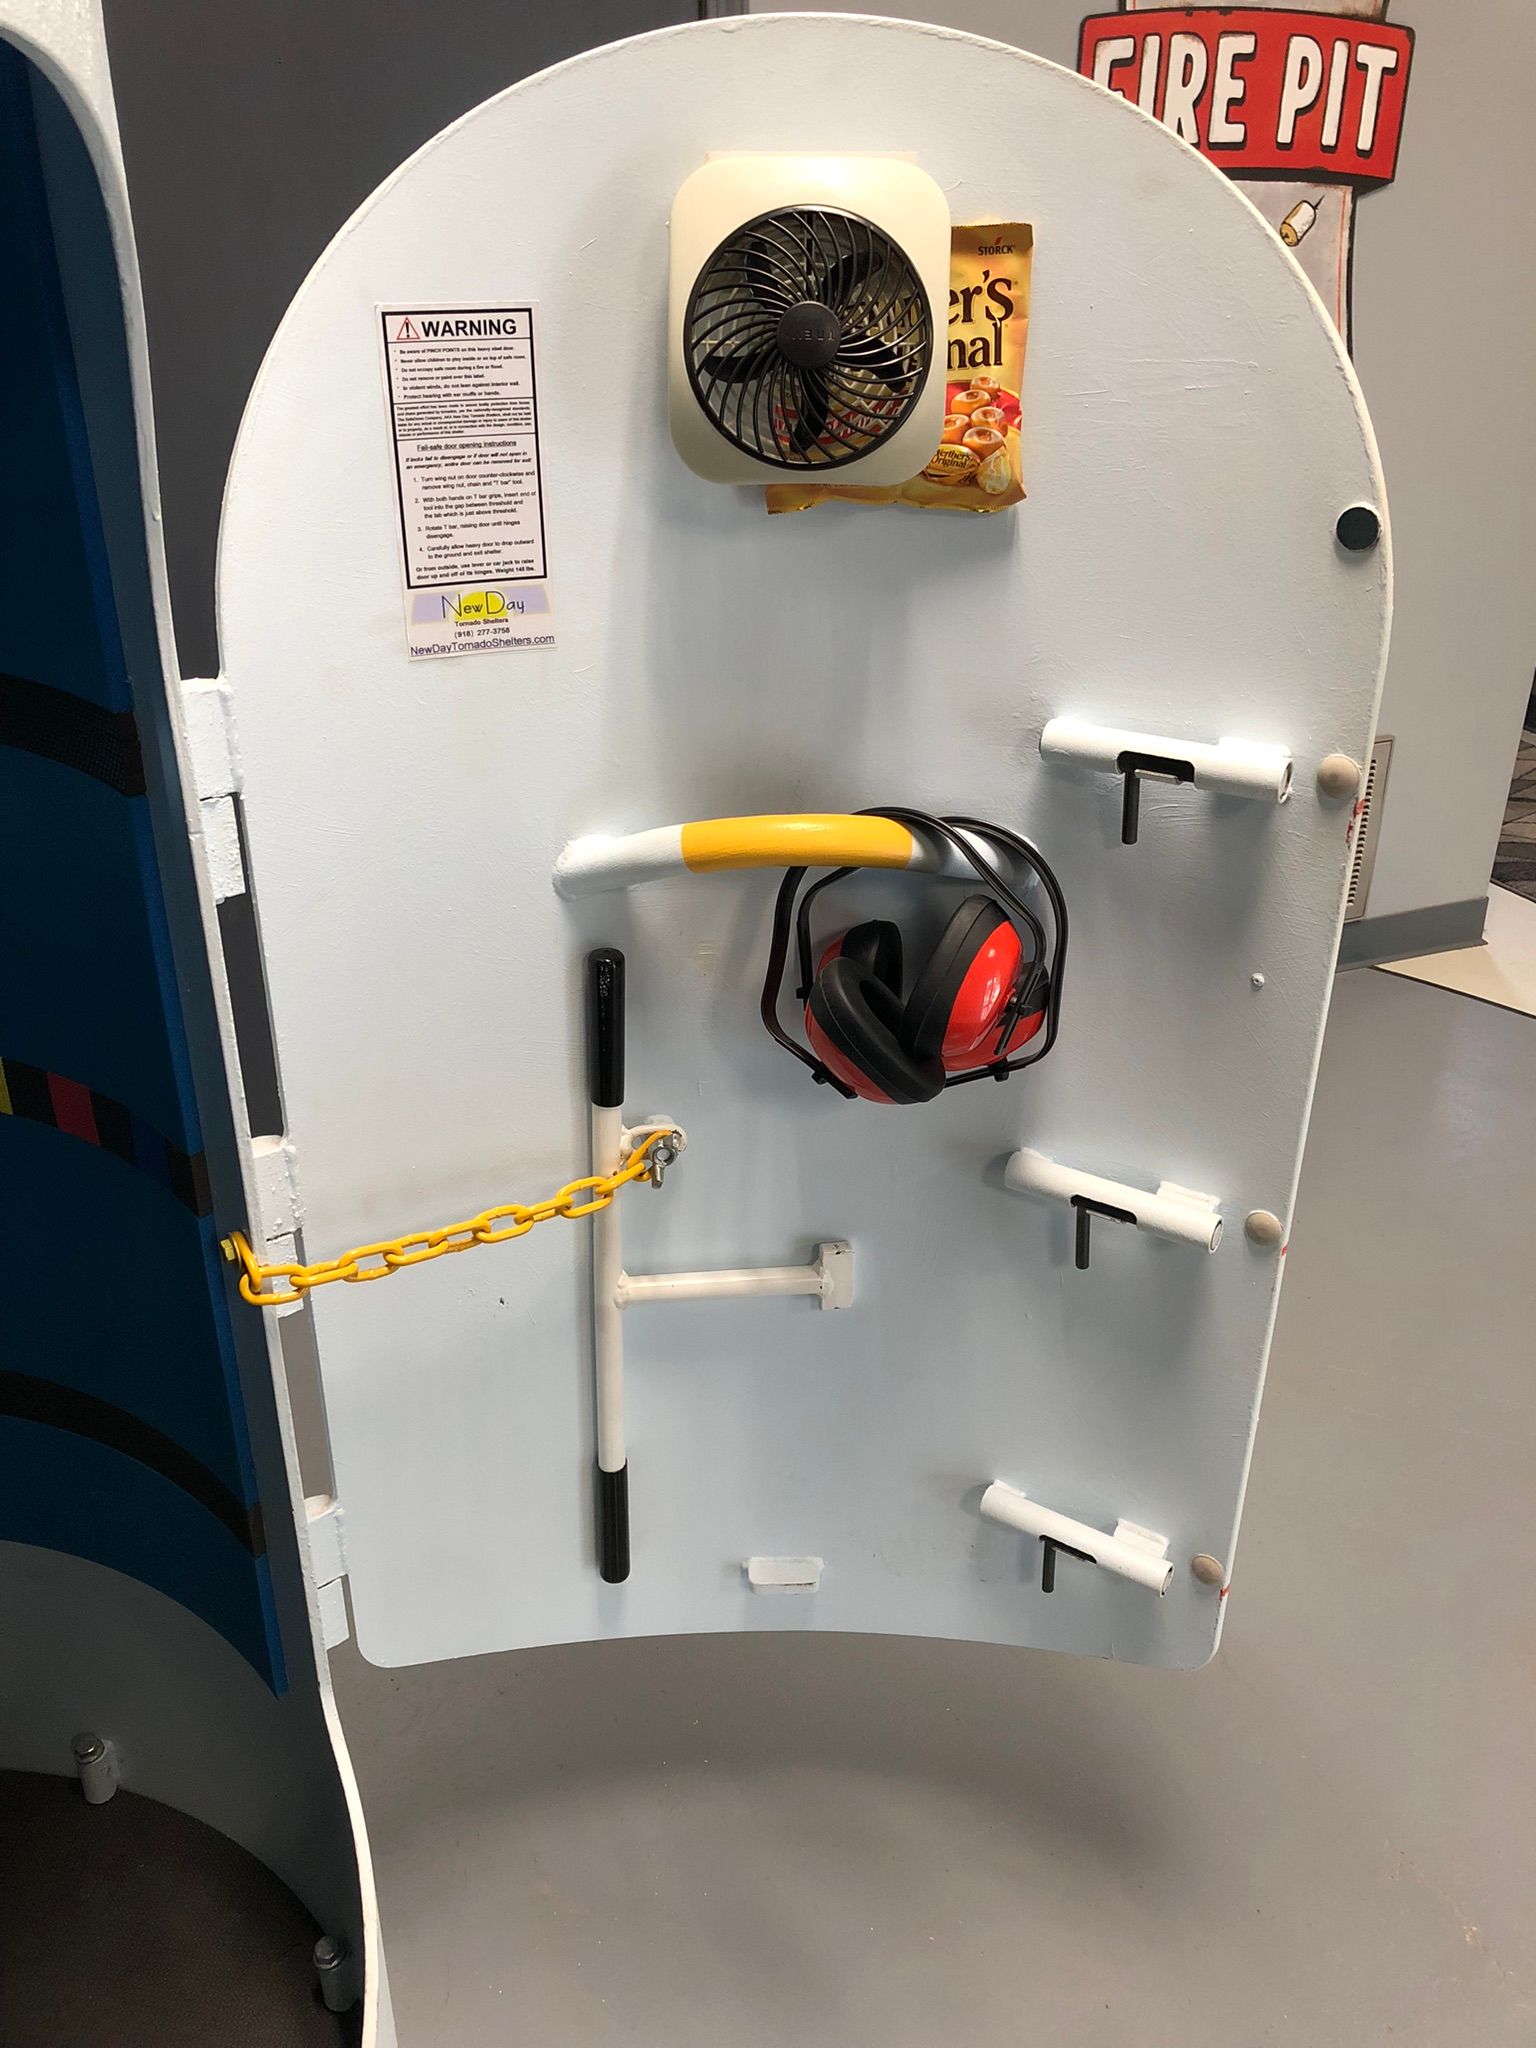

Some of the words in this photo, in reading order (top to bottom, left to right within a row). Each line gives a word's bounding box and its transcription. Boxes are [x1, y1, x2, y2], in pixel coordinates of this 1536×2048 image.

[1093, 31, 1256, 147] FIRE
[1276, 35, 1398, 154] PIT
[977, 245, 1014, 256] STORCK
[421, 318, 517, 337] WARNING
[458, 441, 482, 449] opening
[483, 439, 516, 447] instructions
[454, 630, 474, 639] (918)
[477, 627, 511, 637] 277-3758
[410, 635, 555, 656] NewDayTornadoShelters.com
